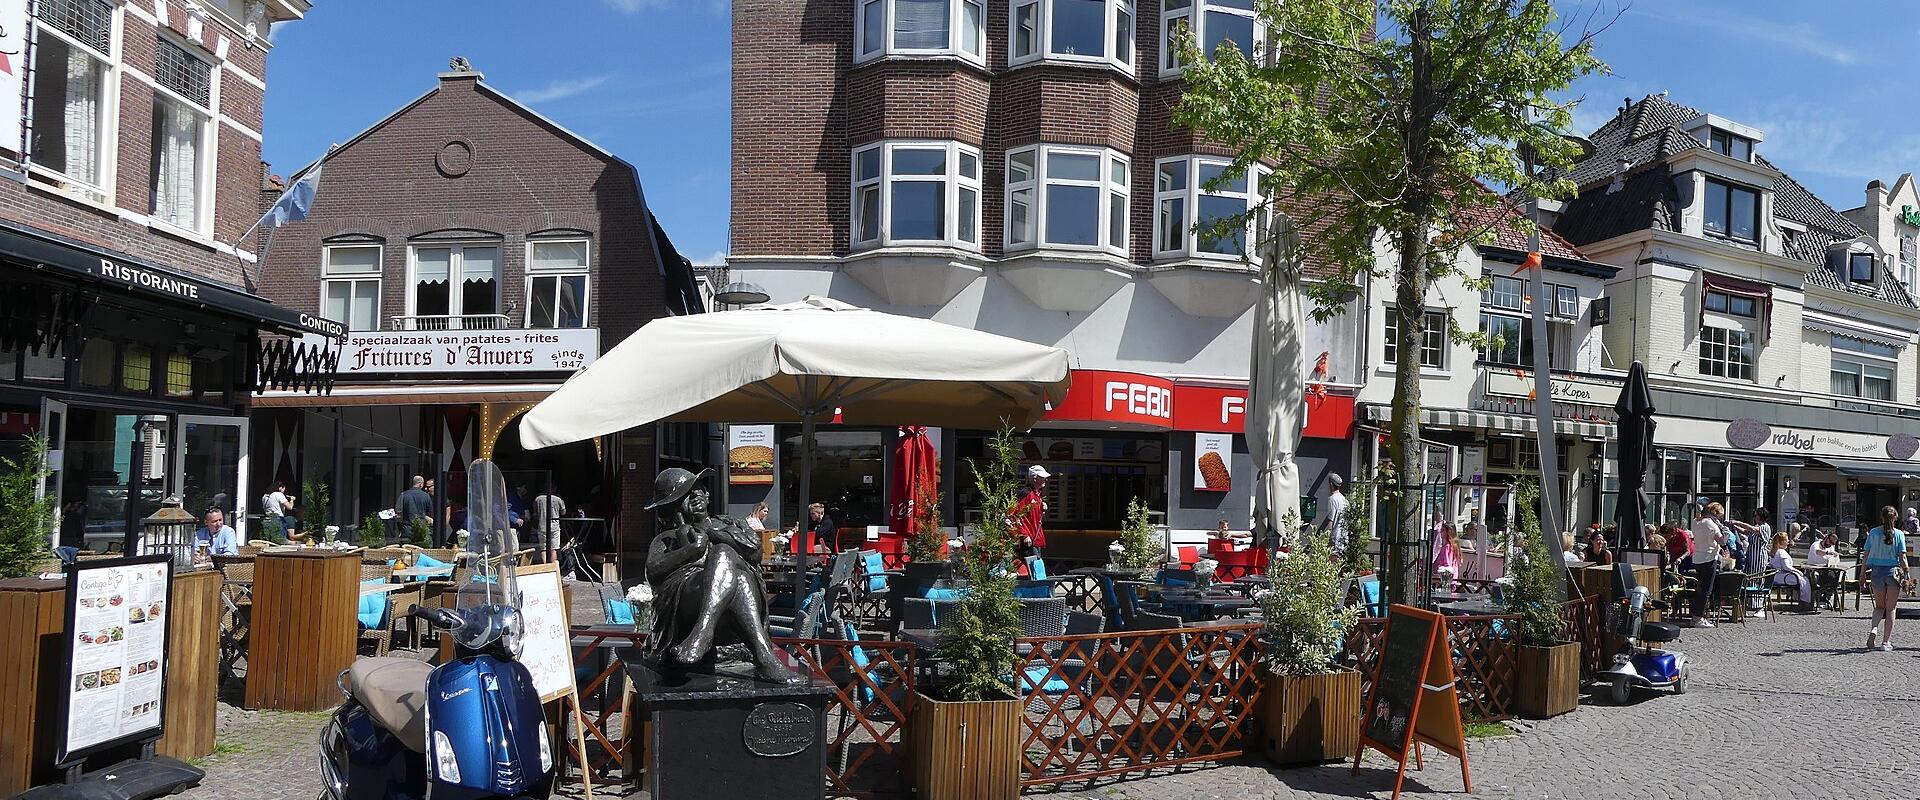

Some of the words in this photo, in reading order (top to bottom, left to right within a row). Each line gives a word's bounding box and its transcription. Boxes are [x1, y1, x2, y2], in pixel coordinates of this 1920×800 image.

[100, 259, 198, 298] RISTORANTE
[300, 313, 343, 335] CONTIGO
[352, 335, 432, 347] speciaalzaak
[436, 336, 458, 344] van
[463, 335, 511, 346] patates
[524, 333, 559, 343] frites
[350, 347, 432, 370] Fritures
[551, 349, 585, 361] sinds
[1106, 381, 1171, 418] FEBO
[1562, 383, 1591, 399] Koper
[1772, 430, 1815, 451] rabbel
